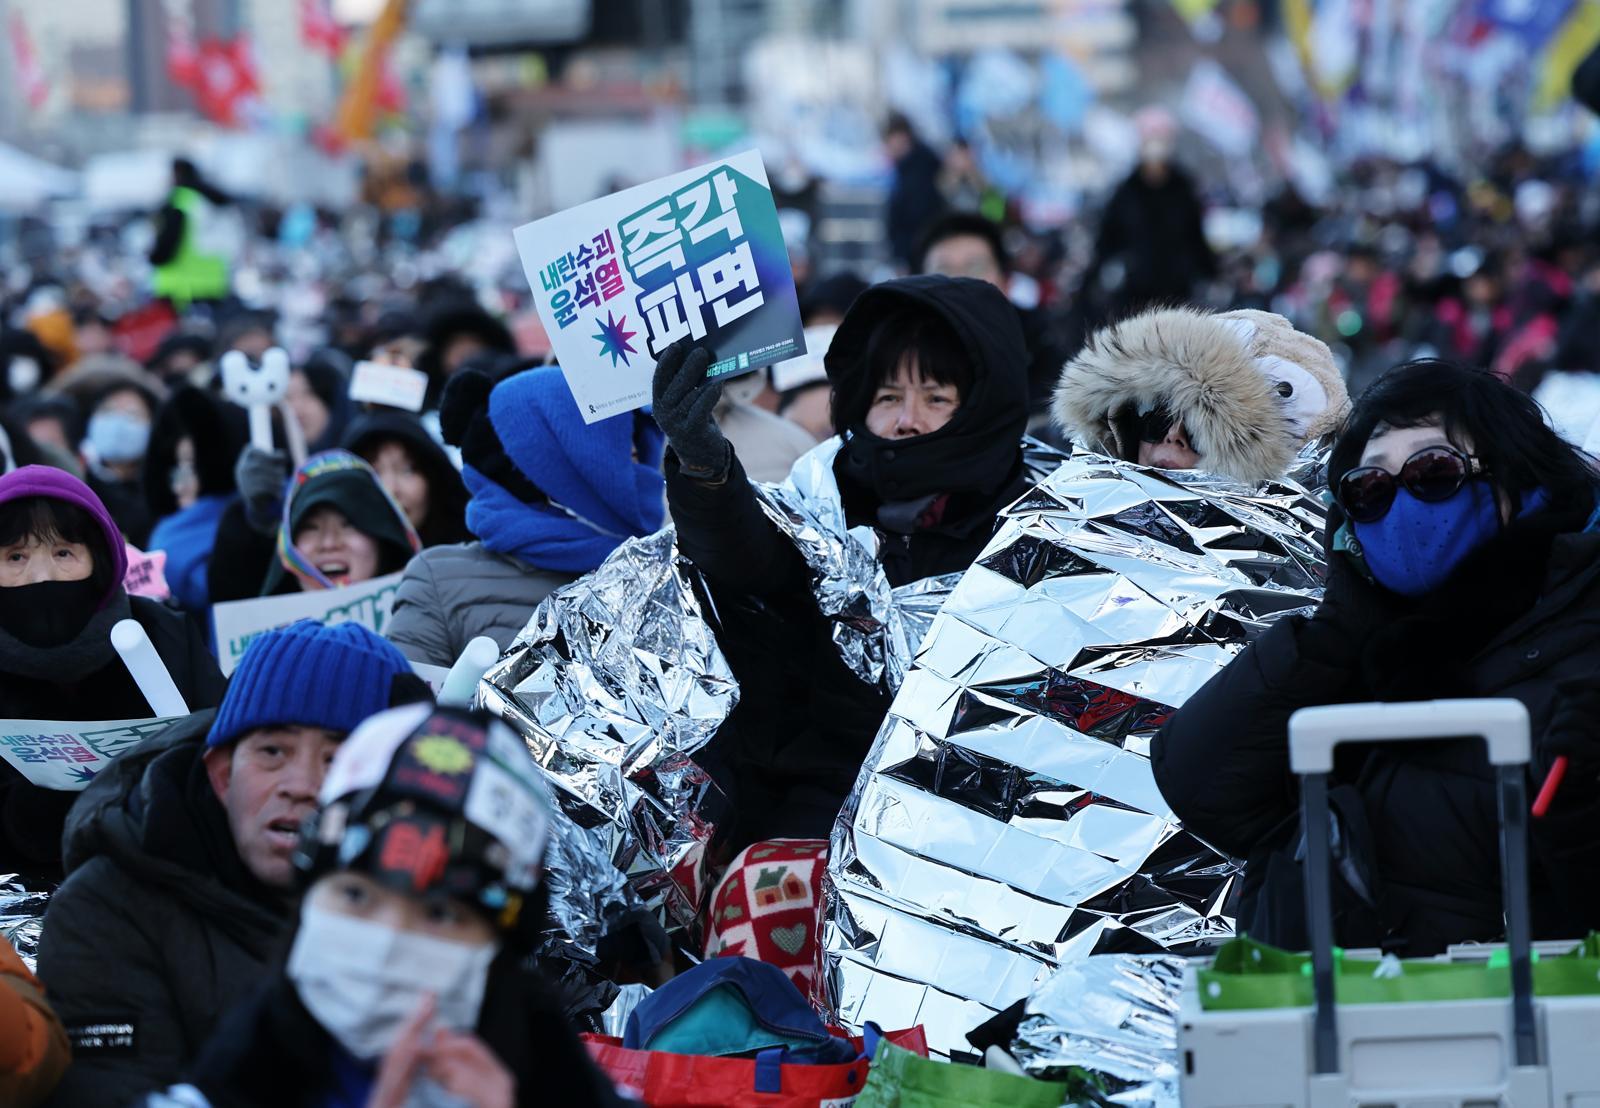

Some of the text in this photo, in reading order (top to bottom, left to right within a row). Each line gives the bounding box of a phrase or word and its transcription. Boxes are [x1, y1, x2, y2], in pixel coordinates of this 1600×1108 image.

[621, 169, 745, 280] 즉각
[539, 228, 616, 292] 내란수괴
[549, 257, 625, 329] 윤석열
[639, 240, 765, 355] 파면
[0, 733, 81, 747] 내란수괴
[11, 746, 99, 763] 윤석열
